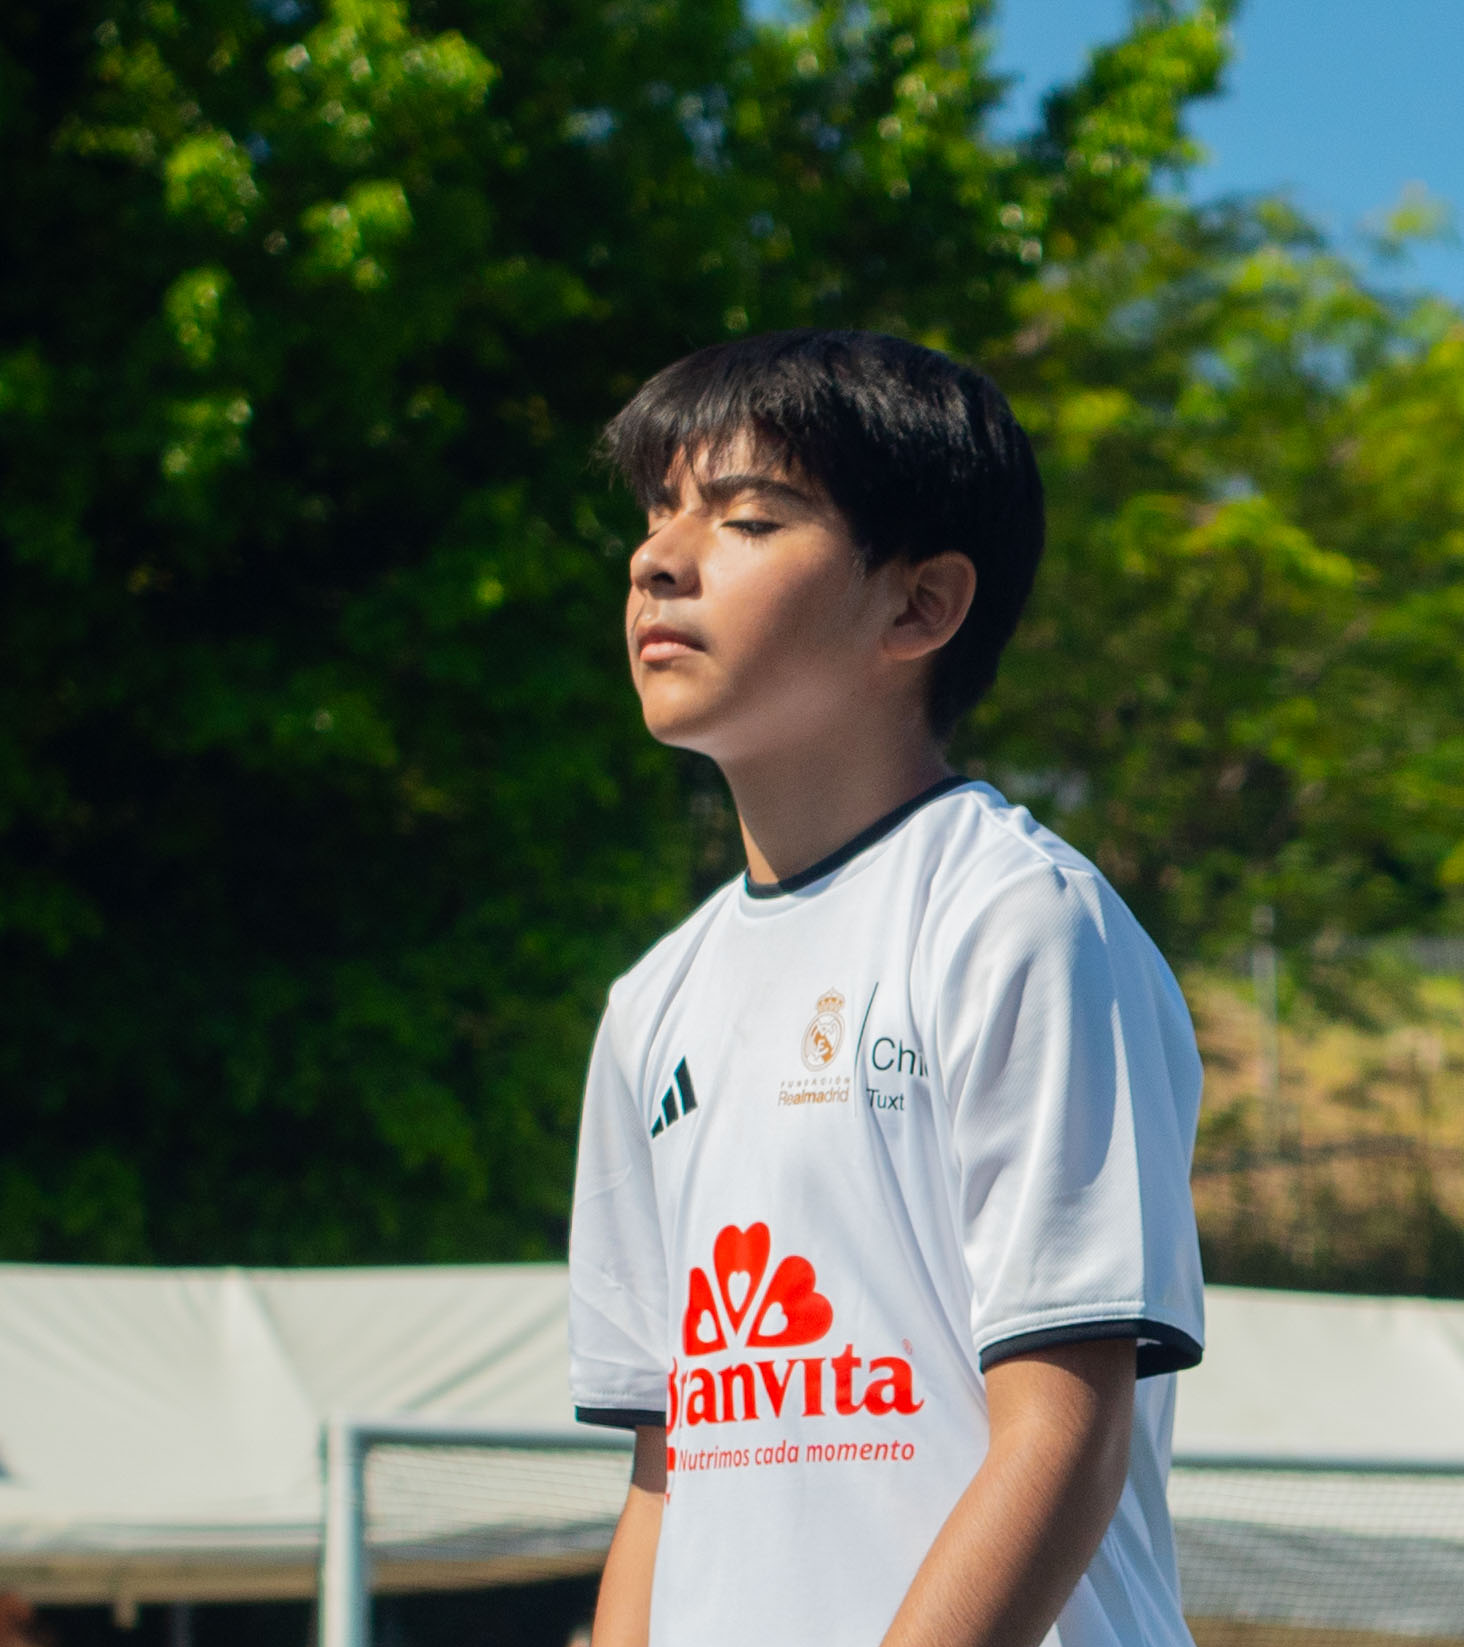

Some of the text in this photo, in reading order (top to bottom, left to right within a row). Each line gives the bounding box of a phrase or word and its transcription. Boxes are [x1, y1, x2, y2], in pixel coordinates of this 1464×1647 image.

[777, 1087, 849, 1107] Realmadrid
[866, 1088, 905, 1111] Tuxt
[677, 1440, 915, 1472] Nutrimos cada momento
